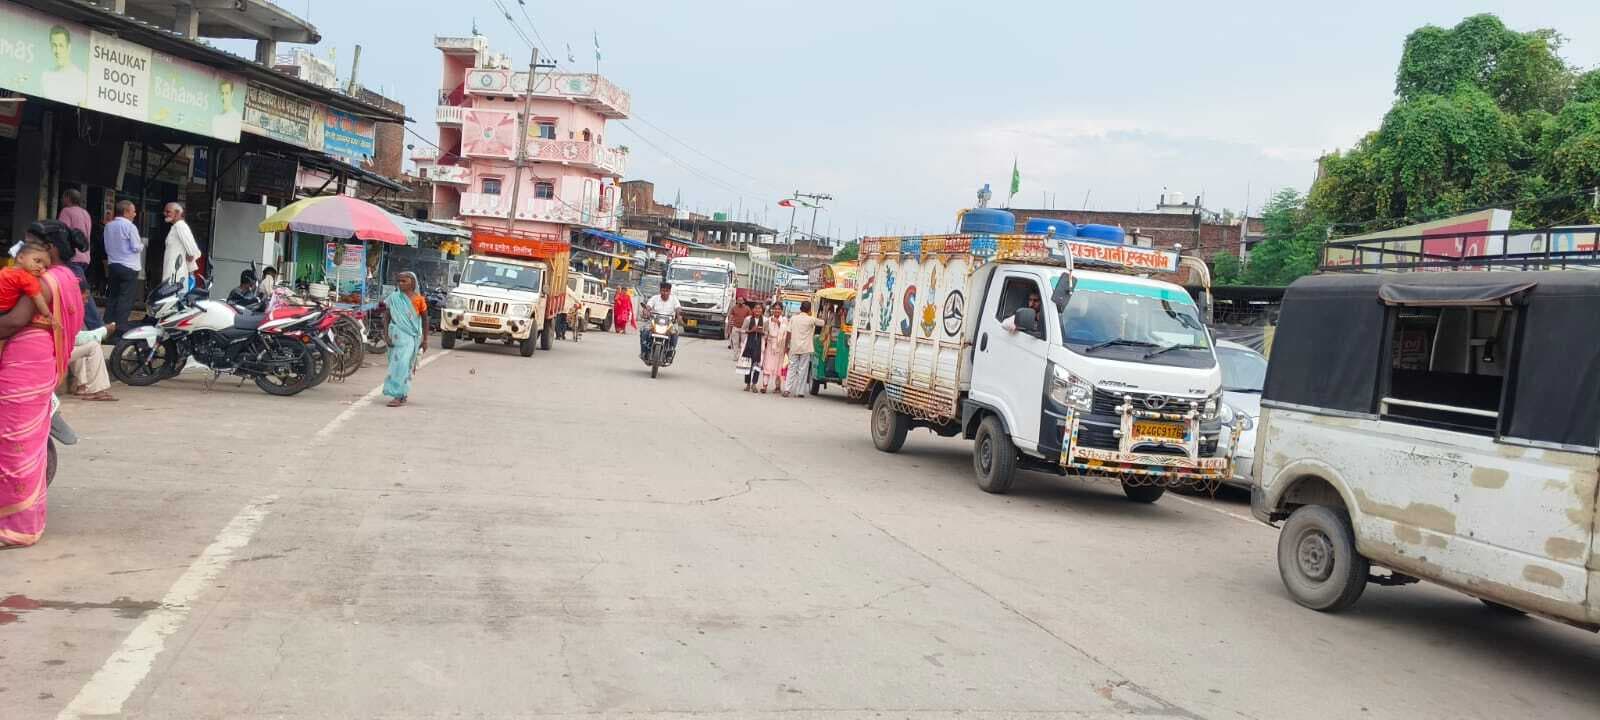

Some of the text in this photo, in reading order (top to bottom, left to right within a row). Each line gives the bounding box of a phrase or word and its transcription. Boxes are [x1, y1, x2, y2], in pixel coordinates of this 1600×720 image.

[94, 45, 147, 72] SHAUKAT
[103, 67, 136, 88] BOOT
[97, 85, 139, 107] HOUSE
